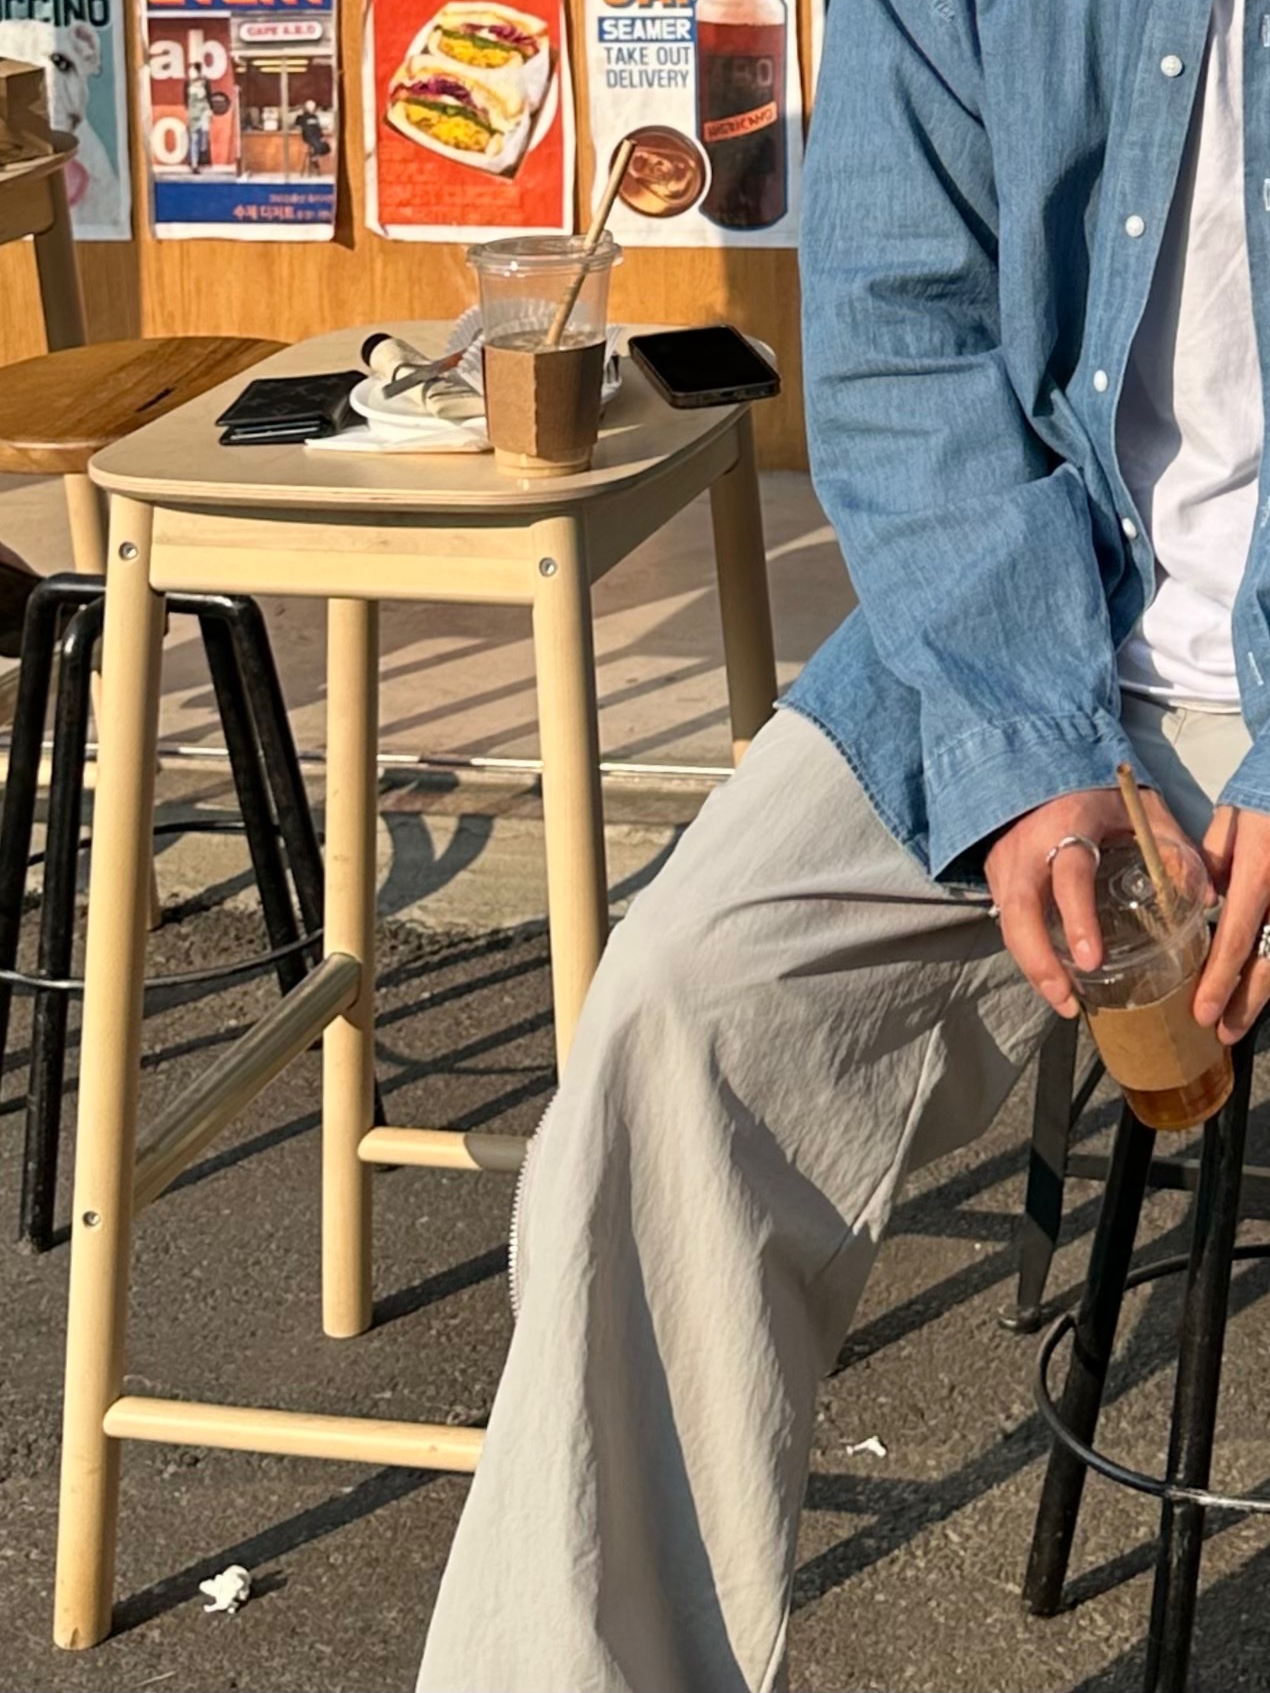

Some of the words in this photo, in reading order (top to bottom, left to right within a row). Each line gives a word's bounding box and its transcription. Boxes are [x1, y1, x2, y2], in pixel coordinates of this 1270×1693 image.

[602, 19, 691, 40] SEAMER
[604, 47, 649, 65] TAKE
[656, 47, 691, 65] OUT
[606, 69, 689, 88] DELIVERY
